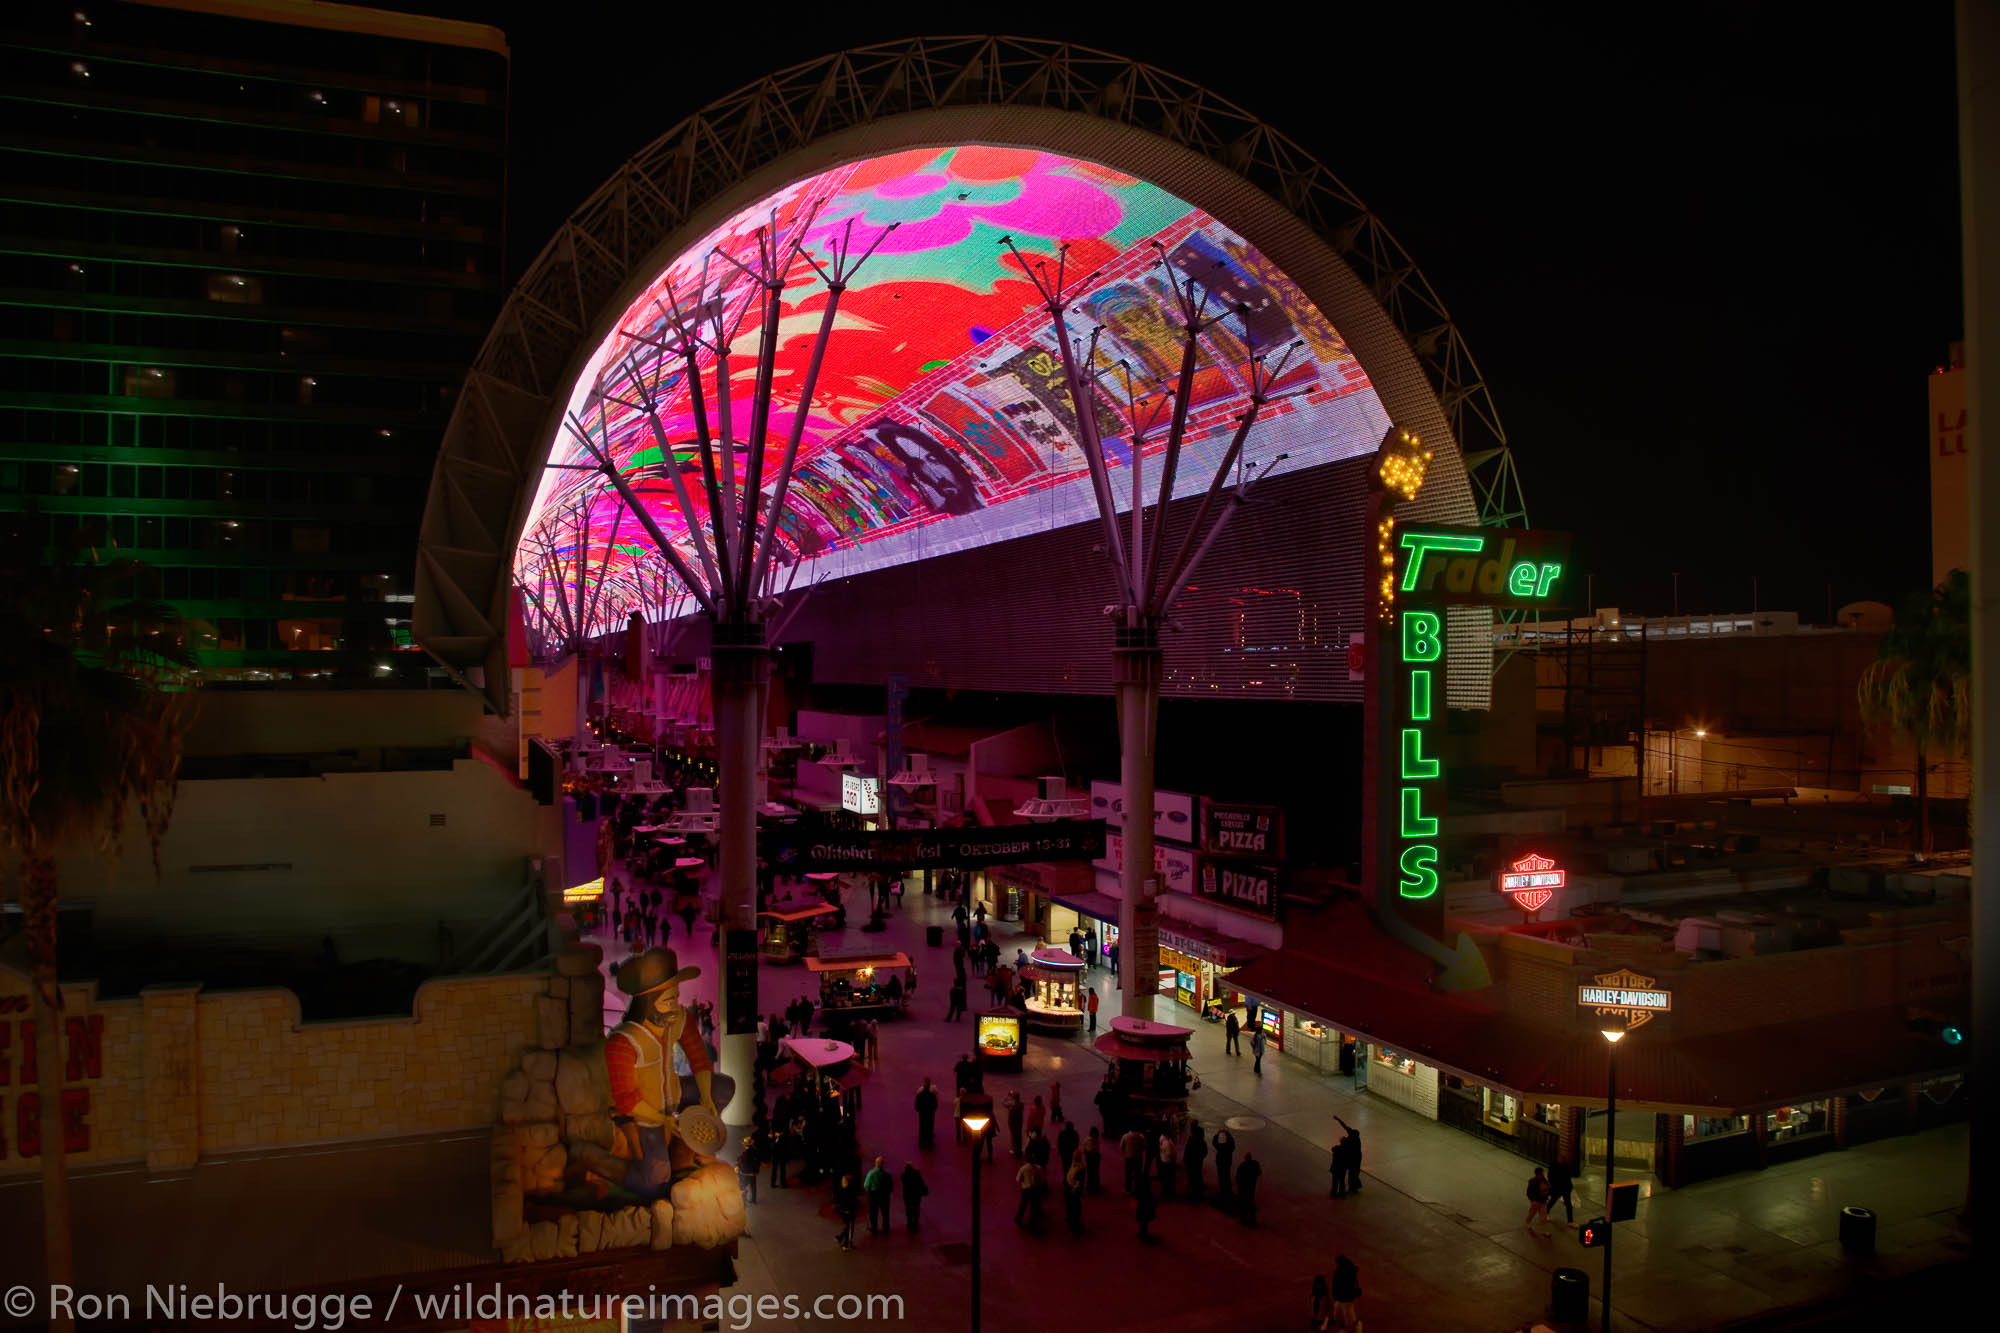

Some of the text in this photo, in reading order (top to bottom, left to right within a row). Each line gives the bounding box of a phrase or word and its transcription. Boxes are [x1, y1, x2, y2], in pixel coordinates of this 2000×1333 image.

[1401, 532, 1561, 597] Trader
[1400, 610, 1441, 899] BILLS
[958, 841, 1031, 857] OKTOBER
[1218, 830, 1266, 851] PIZZA
[1222, 869, 1269, 908] PIZZA
[1602, 974, 1648, 988] MOTOR
[1582, 988, 1667, 1008] HARLEY-DAVIDSON
